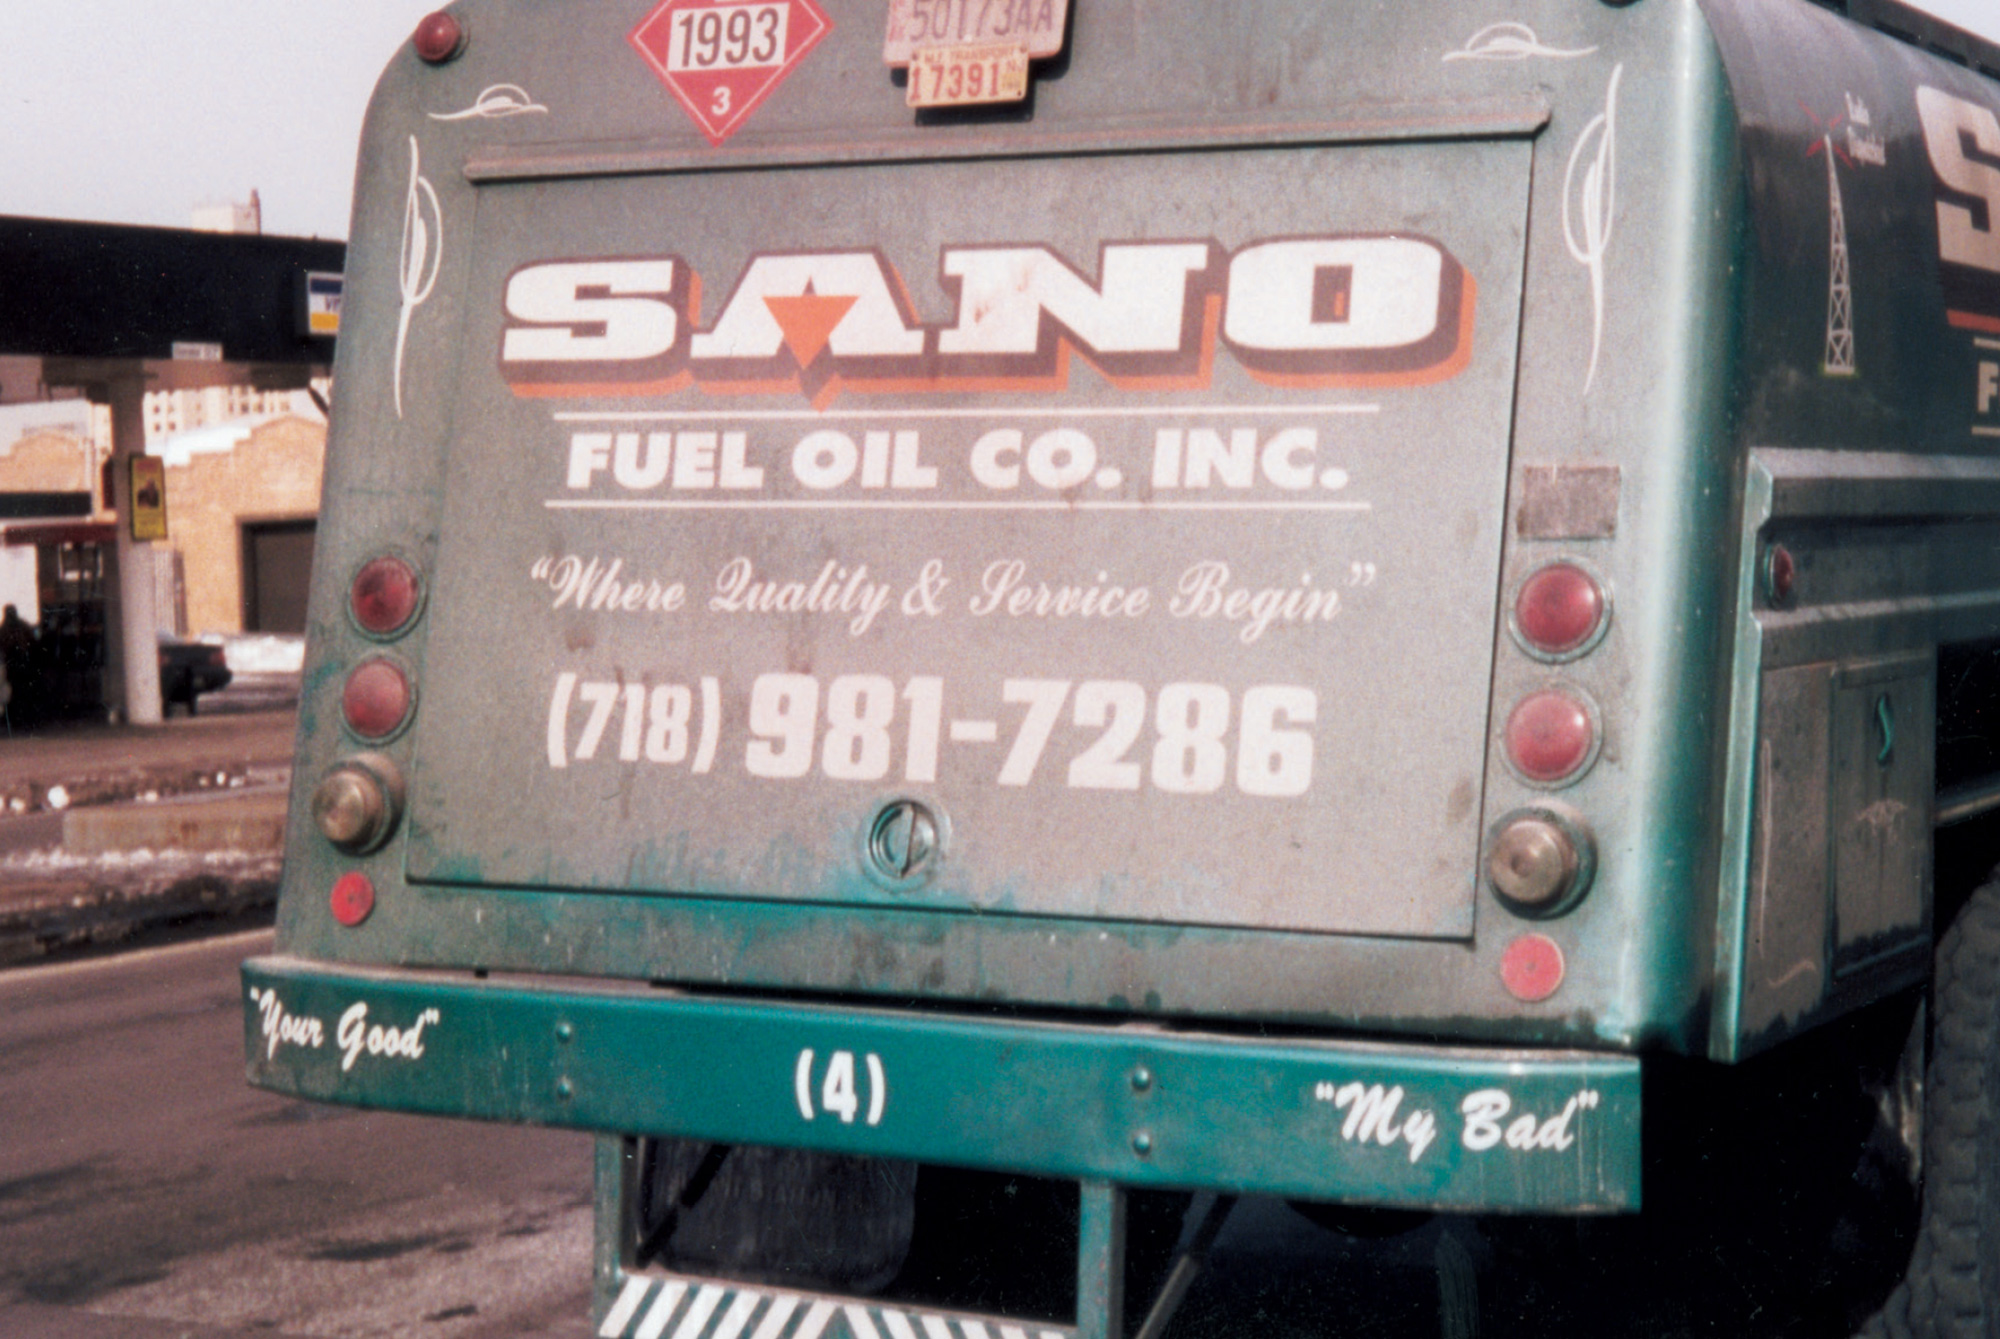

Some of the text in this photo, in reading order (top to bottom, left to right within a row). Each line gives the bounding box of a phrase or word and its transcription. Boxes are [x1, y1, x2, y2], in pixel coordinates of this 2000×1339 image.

[678, 7, 779, 67] 1993
[711, 86, 731, 116] 3
[910, 62, 999, 100] 17391
[500, 233, 1470, 388] SANO
[566, 427, 1349, 491] FUEL OIL CO. INC.
[708, 556, 891, 636] Quality
[901, 558, 951, 617] &
[968, 559, 1151, 618] Service
[547, 672, 1318, 798] (718) 981-7286
[795, 1048, 886, 1126] (4)
